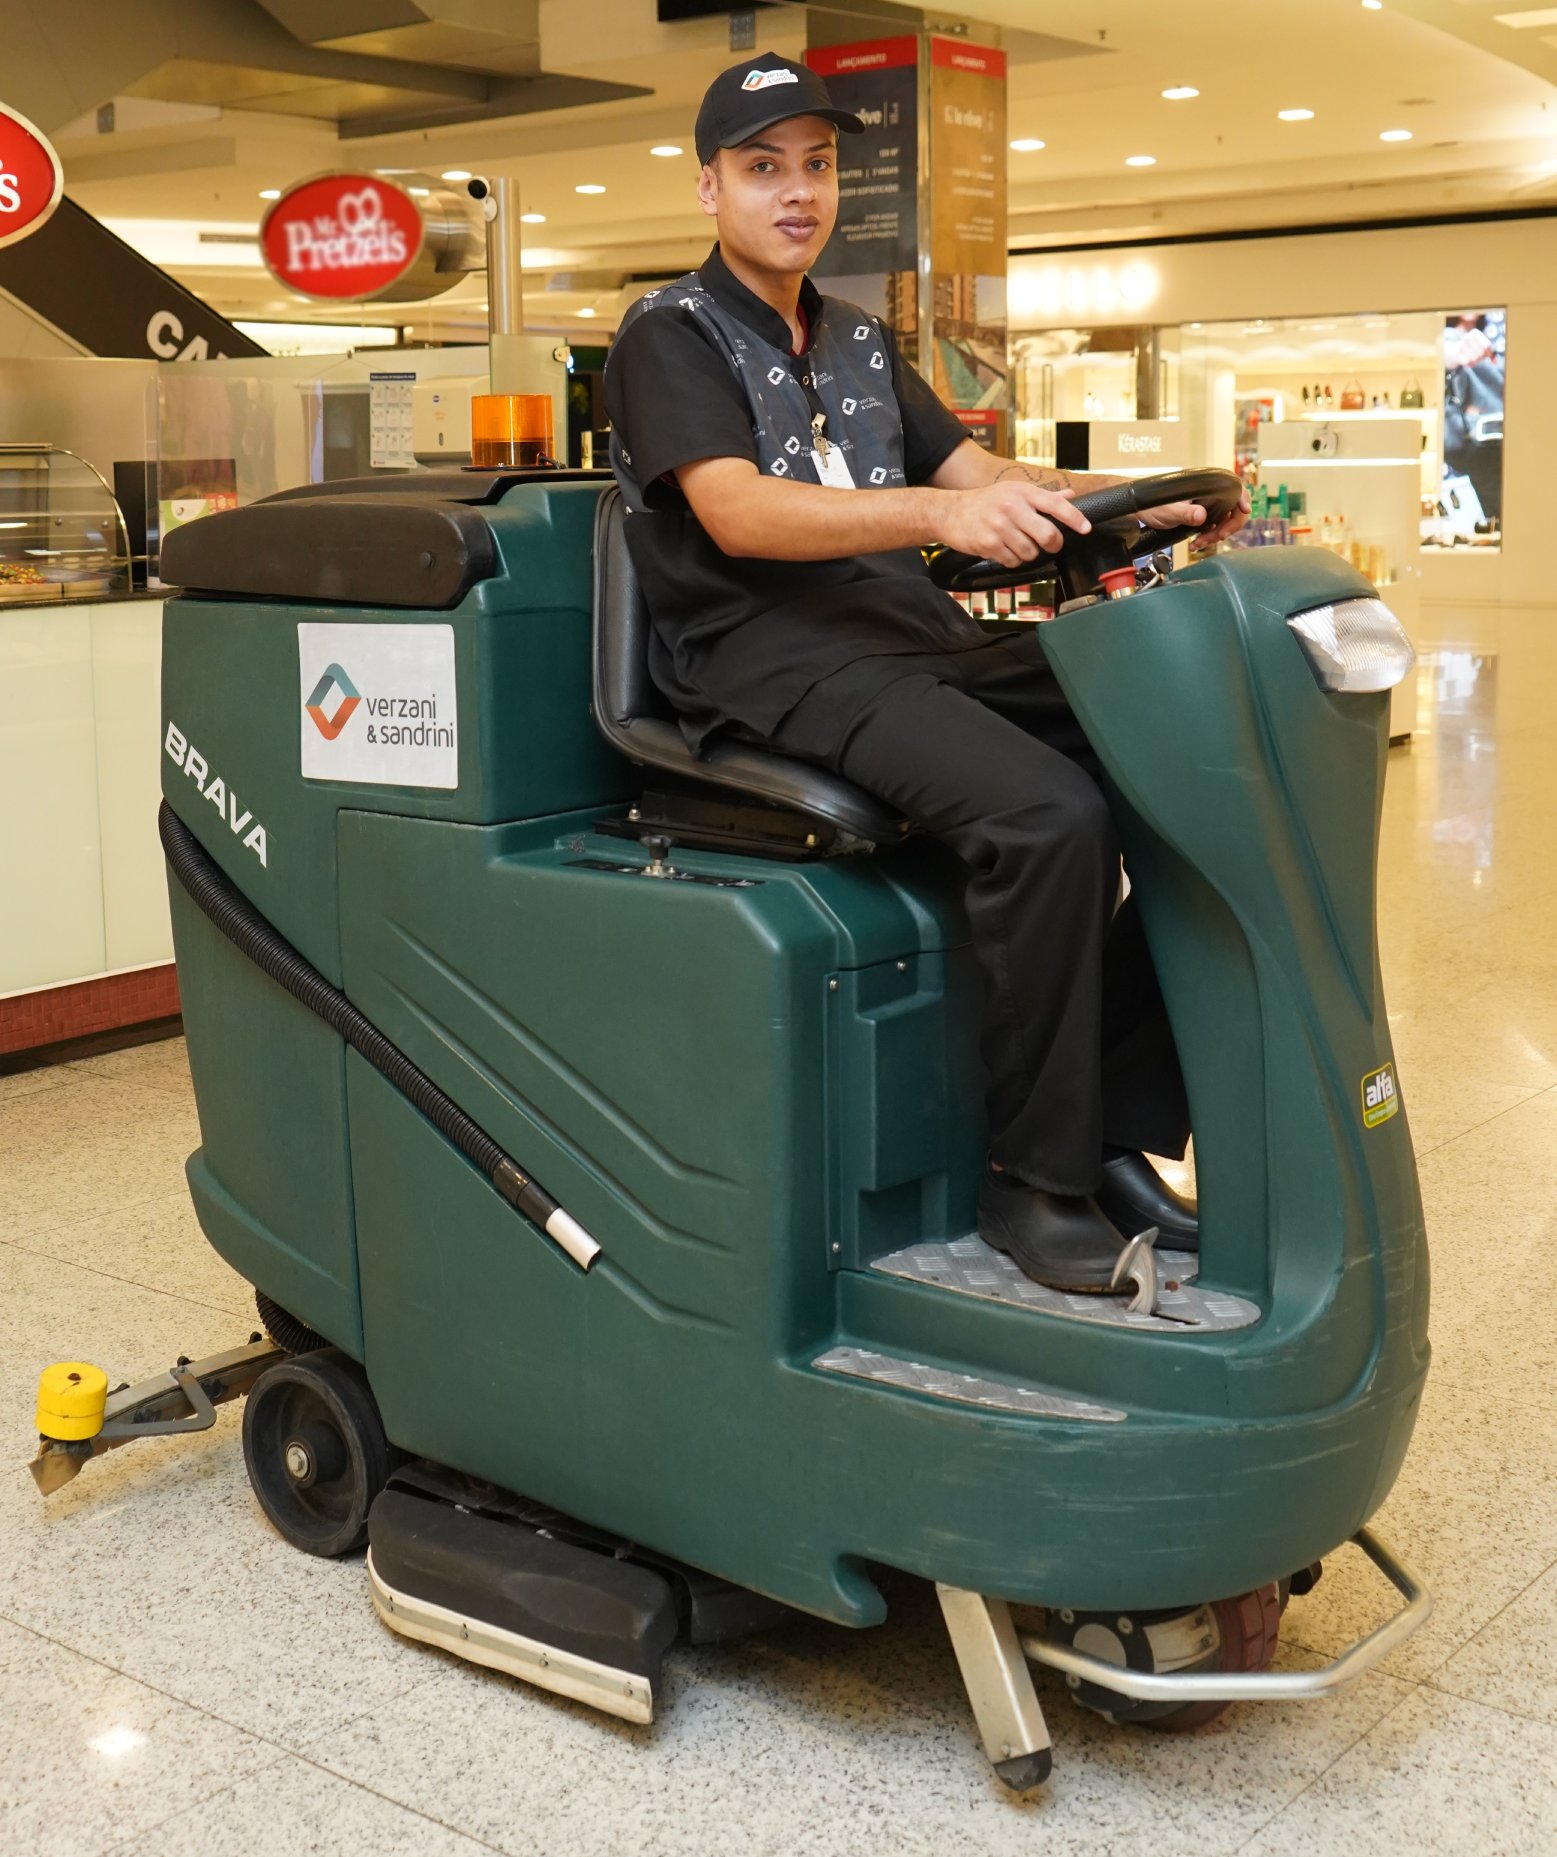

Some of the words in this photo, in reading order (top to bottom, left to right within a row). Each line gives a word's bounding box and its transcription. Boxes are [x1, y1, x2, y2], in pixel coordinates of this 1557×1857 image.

[283, 217, 408, 273] Pretzels
[366, 693, 436, 719] verzani
[367, 724, 377, 744] &
[380, 721, 454, 748] sandrini
[164, 720, 267, 869] BRAVA
[1366, 1071, 1394, 1108] alfa
